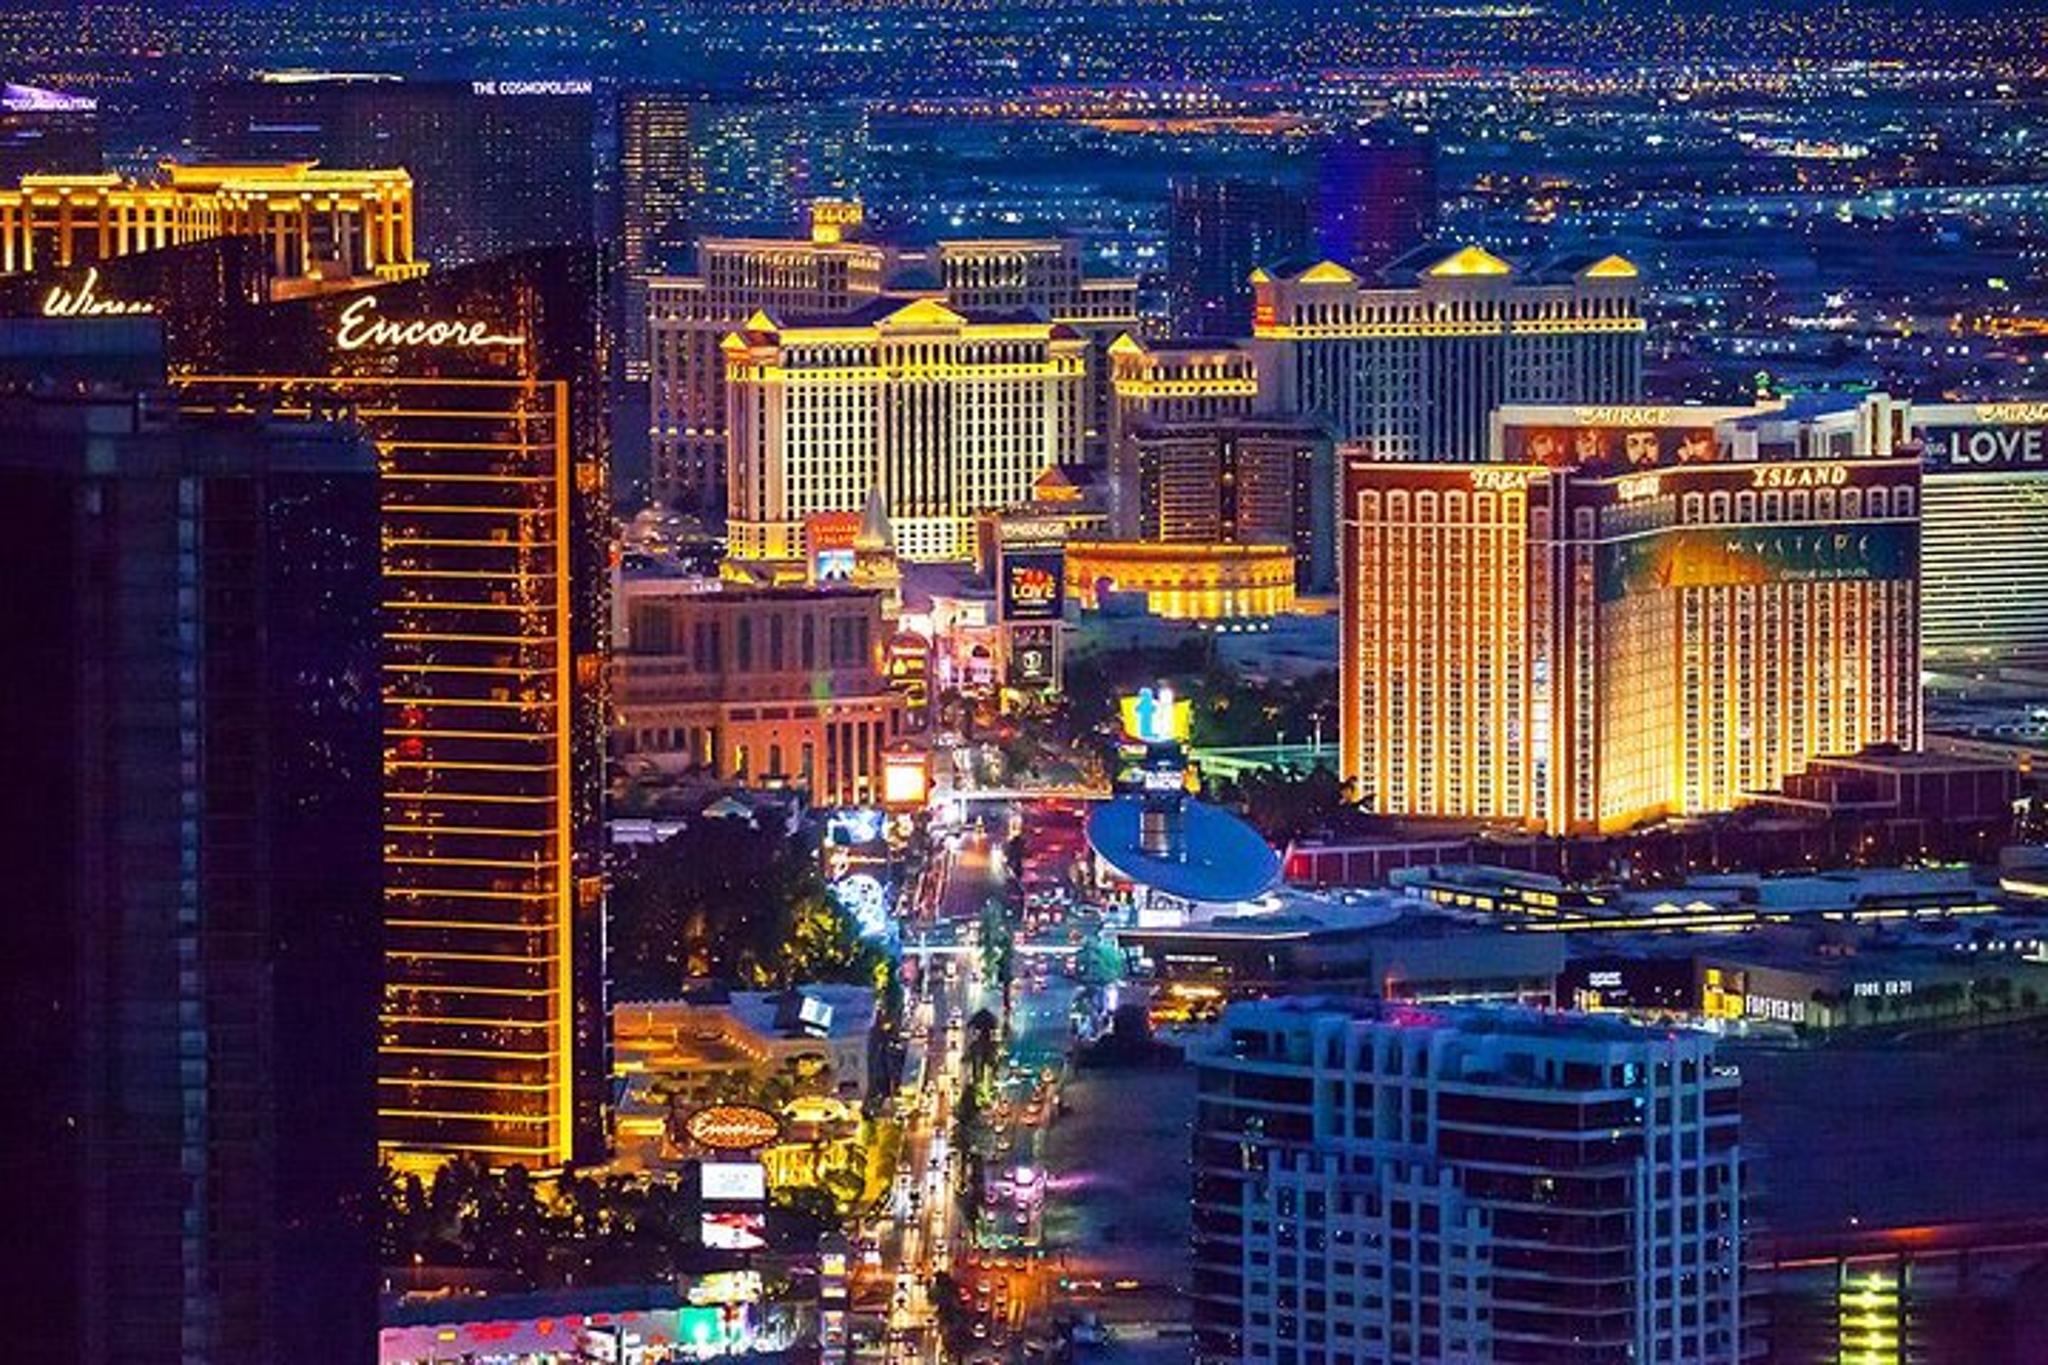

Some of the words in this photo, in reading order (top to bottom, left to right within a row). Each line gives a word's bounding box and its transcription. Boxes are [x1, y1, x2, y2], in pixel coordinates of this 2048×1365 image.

[472, 81, 496, 95] THE
[500, 81, 592, 95] COSMOPOLITAN
[337, 295, 526, 349] Encore
[1951, 430, 2043, 464] LOVE
[1752, 466, 1847, 487] ISLAND
[1746, 995, 1790, 1020] FOREVER
